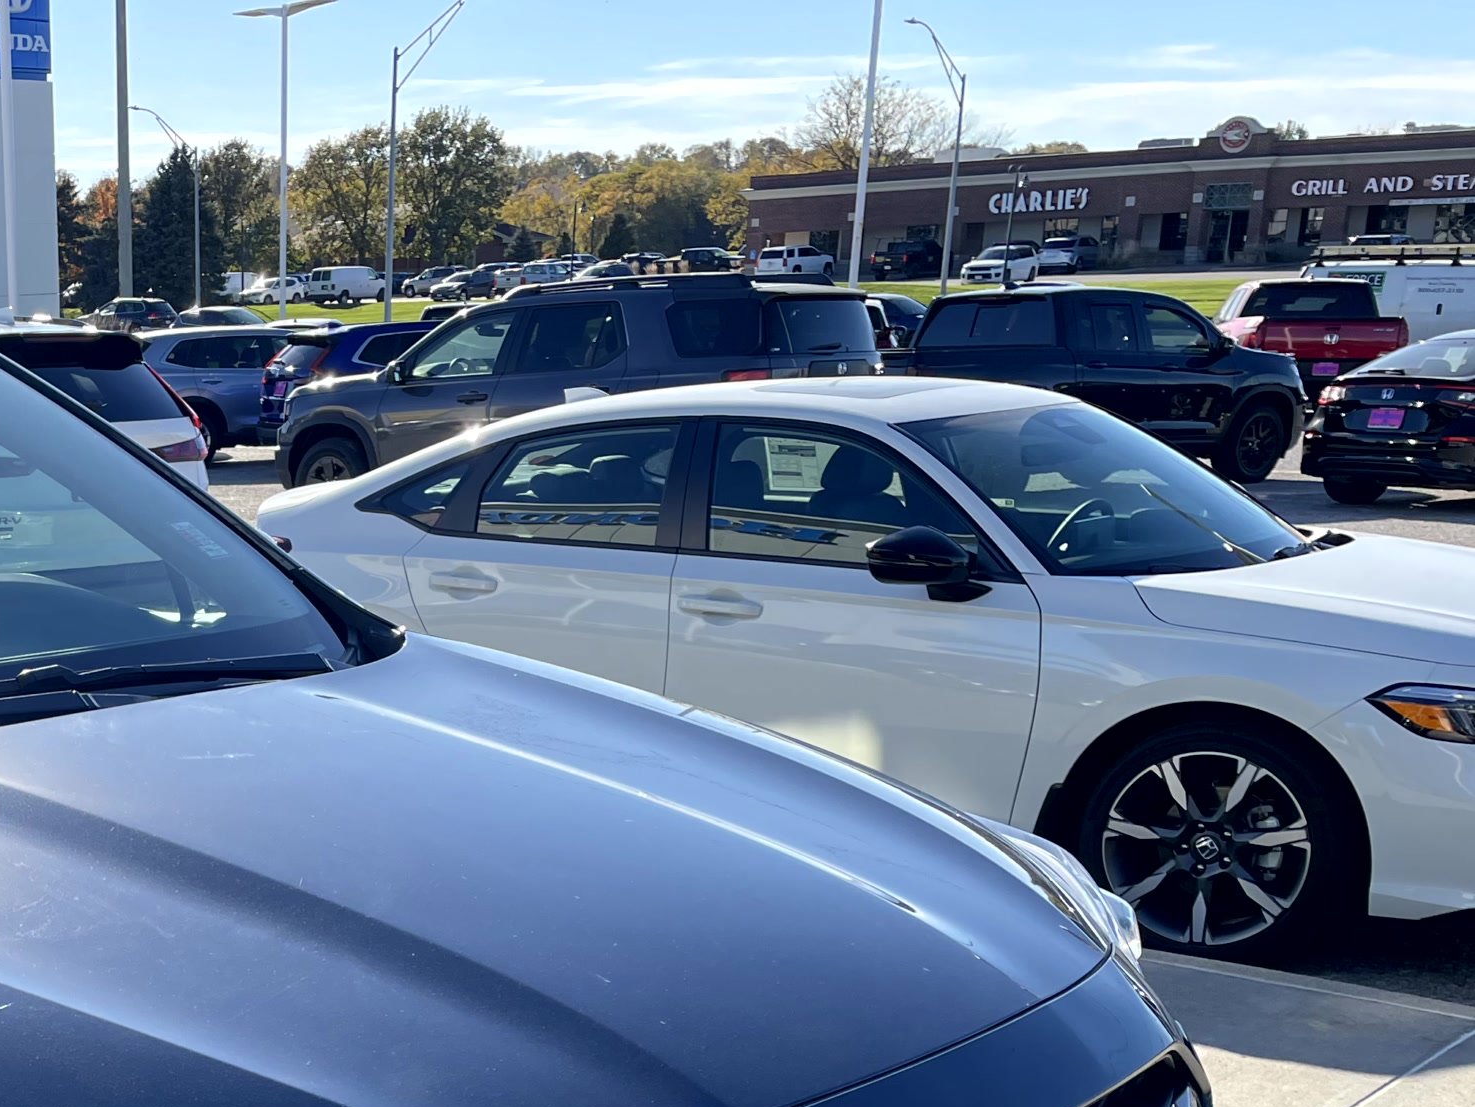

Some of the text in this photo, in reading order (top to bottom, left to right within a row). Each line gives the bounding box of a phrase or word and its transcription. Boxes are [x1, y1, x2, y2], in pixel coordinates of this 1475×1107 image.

[1291, 178, 1348, 196] GRILL
[1363, 175, 1414, 193] AND
[988, 187, 1089, 214] CHARLIE'S
